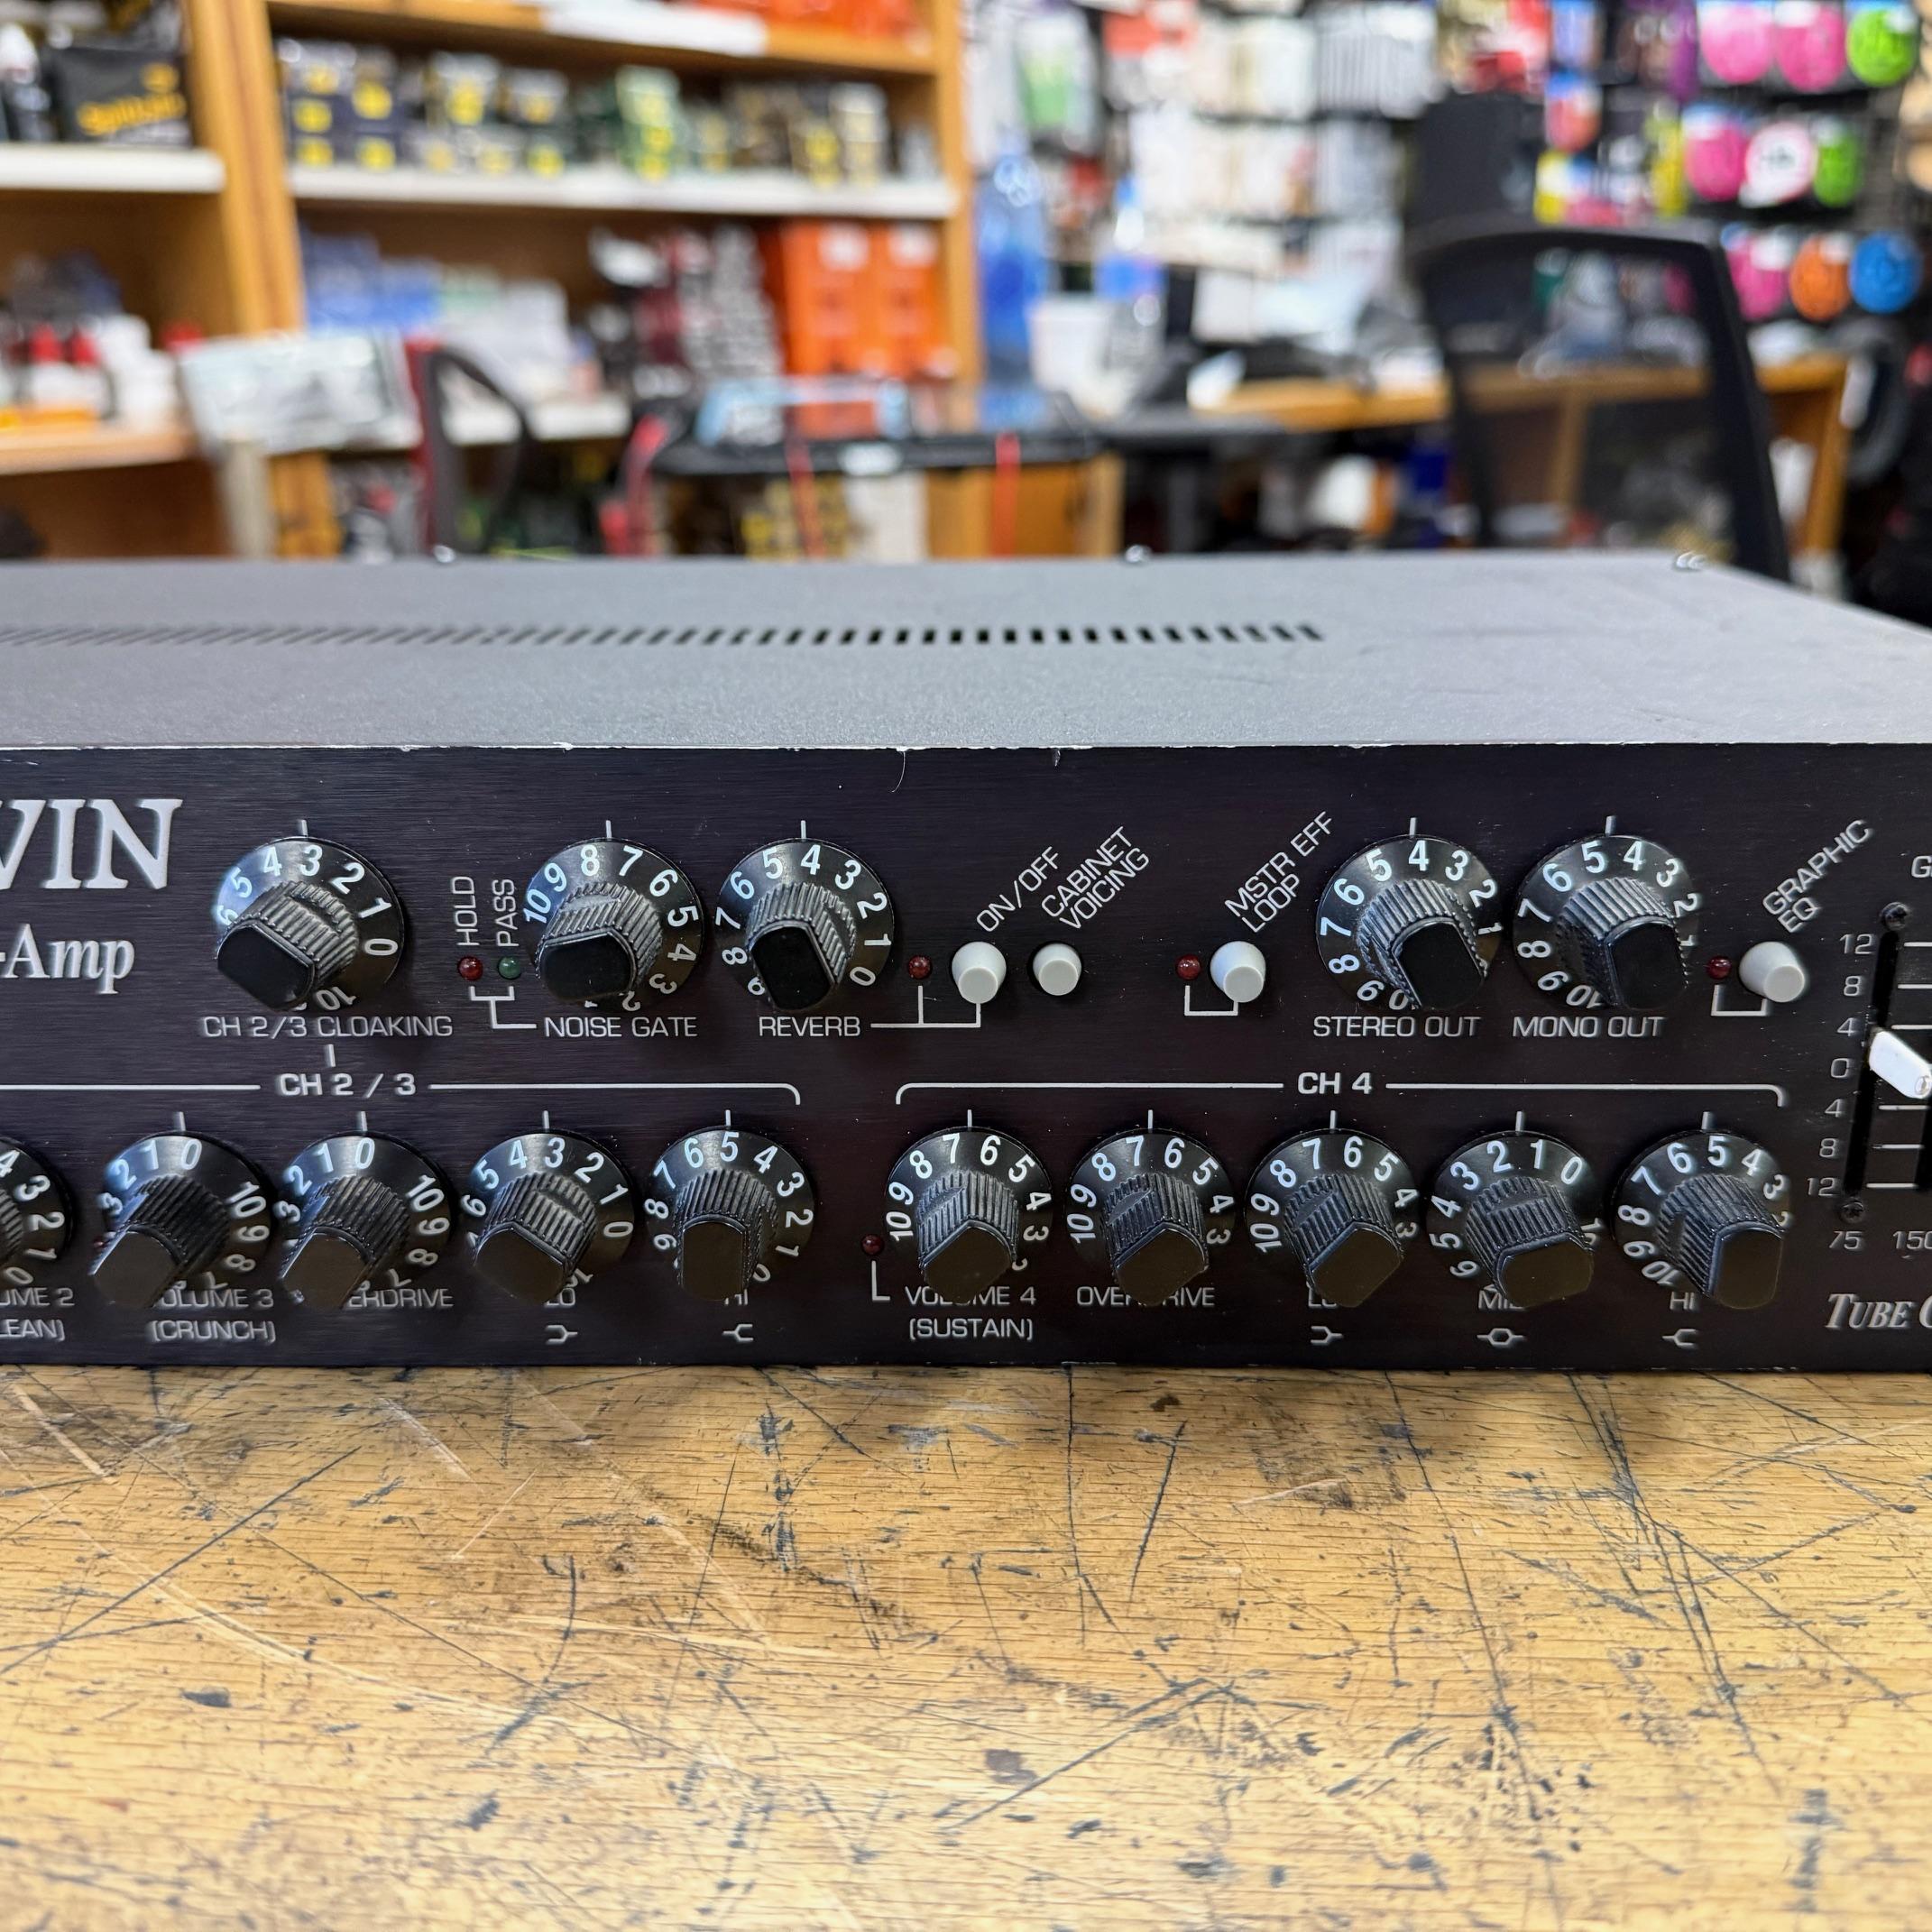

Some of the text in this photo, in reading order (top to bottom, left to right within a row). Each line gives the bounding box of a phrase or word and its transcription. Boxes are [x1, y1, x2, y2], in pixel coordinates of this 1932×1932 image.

[976, 847, 1059, 932] ON/OFF
[1041, 827, 1133, 918] CABINET
[1060, 848, 1150, 930] VOICING
[1225, 811, 1332, 918] MSTR EFF
[1762, 820, 1872, 915] GRAPHIC
[232, 844, 398, 956] 5 4 3 2 1 0
[452, 877, 480, 946] HOLD
[492, 879, 519, 948] PASS
[523, 846, 698, 963] 10 9 8 7 6 5 4
[716, 845, 891, 987] 6 5 4 3 2 1 0 8 7
[1242, 874, 1299, 933] LOOP
[1320, 841, 1498, 1002] 9 8 7 6 5 4 3 2
[1518, 841, 1698, 992] 9 8 7 6 5 4 3 2
[1777, 897, 1820, 933] EQ
[1840, 934, 1873, 954] 12
[1844, 976, 1861, 996] 8
[204, 1016, 453, 1040] CH 2/3 CLOAKING
[545, 1017, 697, 1038] NOISE GATE
[759, 1017, 860, 1037] REVERB
[1314, 1017, 1481, 1037] STEREO OUT
[1513, 1017, 1664, 1038] MONO OUT
[1836, 1017, 1854, 1036] 4
[279, 1074, 323, 1096] CH
[1298, 1072, 1372, 1094] CH 4
[1831, 1058, 1849, 1078] 0
[1825, 1099, 1842, 1118] 4
[1819, 1138, 1837, 1157] 8
[100, 1139, 270, 1243] 3 2 1 0 10 9
[274, 1137, 449, 1236] 3 2 1 0 10 9
[461, 1137, 633, 1237] 6 5 4 3 2 1 0
[644, 1132, 814, 1250] 9 8 7 6 5 4 3 2
[886, 1133, 1052, 1242] 10 9 8 7 6 5 4
[1067, 1136, 1234, 1244] 10 9 8 7 6 5 4
[1250, 1136, 1419, 1253] 10 9 8 7 6 5 4
[1430, 1138, 1585, 1250] 5 4 3 2 1 0
[1618, 1136, 1787, 1258] 9 8 7 6 5 4 3
[1807, 1177, 1836, 1196] 12
[5, 1174, 65, 1285] 3 2 0
[1829, 1231, 1864, 1249] 75
[58, 1288, 74, 1306] 2
[158, 1288, 273, 1308] OLUME 3
[1020, 1287, 1036, 1304] 4
[0, 1320, 64, 1342] EAN)
[149, 1320, 276, 1342] (CRUNCH)
[910, 1318, 1033, 1339] (SUSTAIN)
